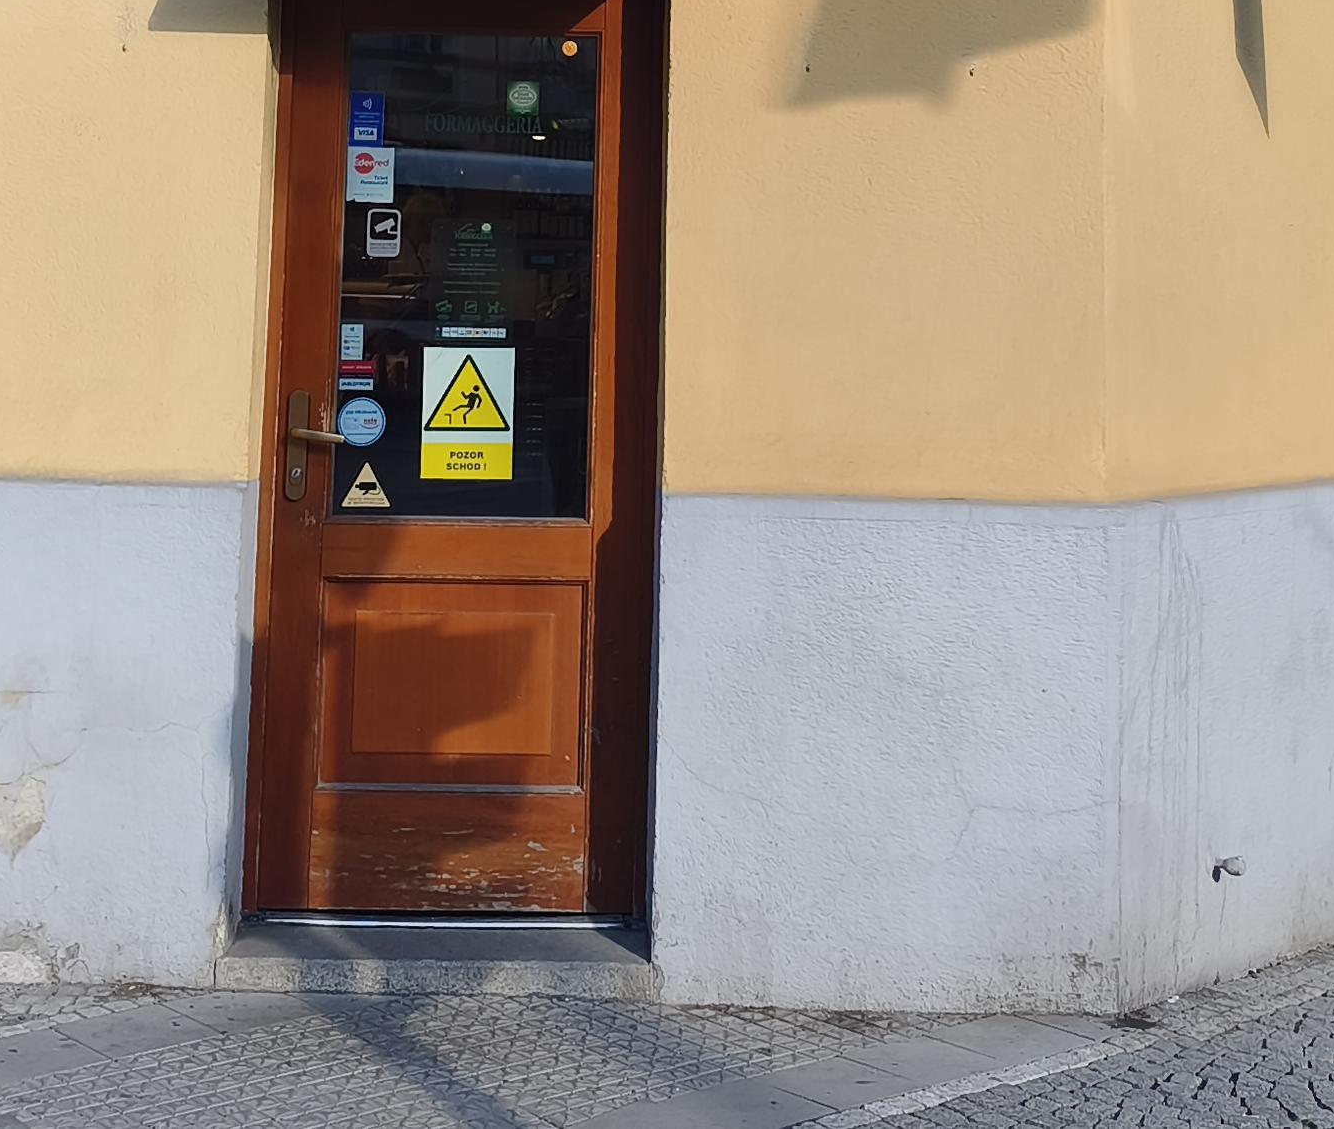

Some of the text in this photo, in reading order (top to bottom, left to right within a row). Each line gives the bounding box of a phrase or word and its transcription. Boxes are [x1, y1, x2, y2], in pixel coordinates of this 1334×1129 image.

[425, 113, 543, 134] FORMAGGERIA
[357, 128, 375, 137] VISA
[449, 450, 484, 460] POZOR
[446, 462, 481, 471] SCHOD
